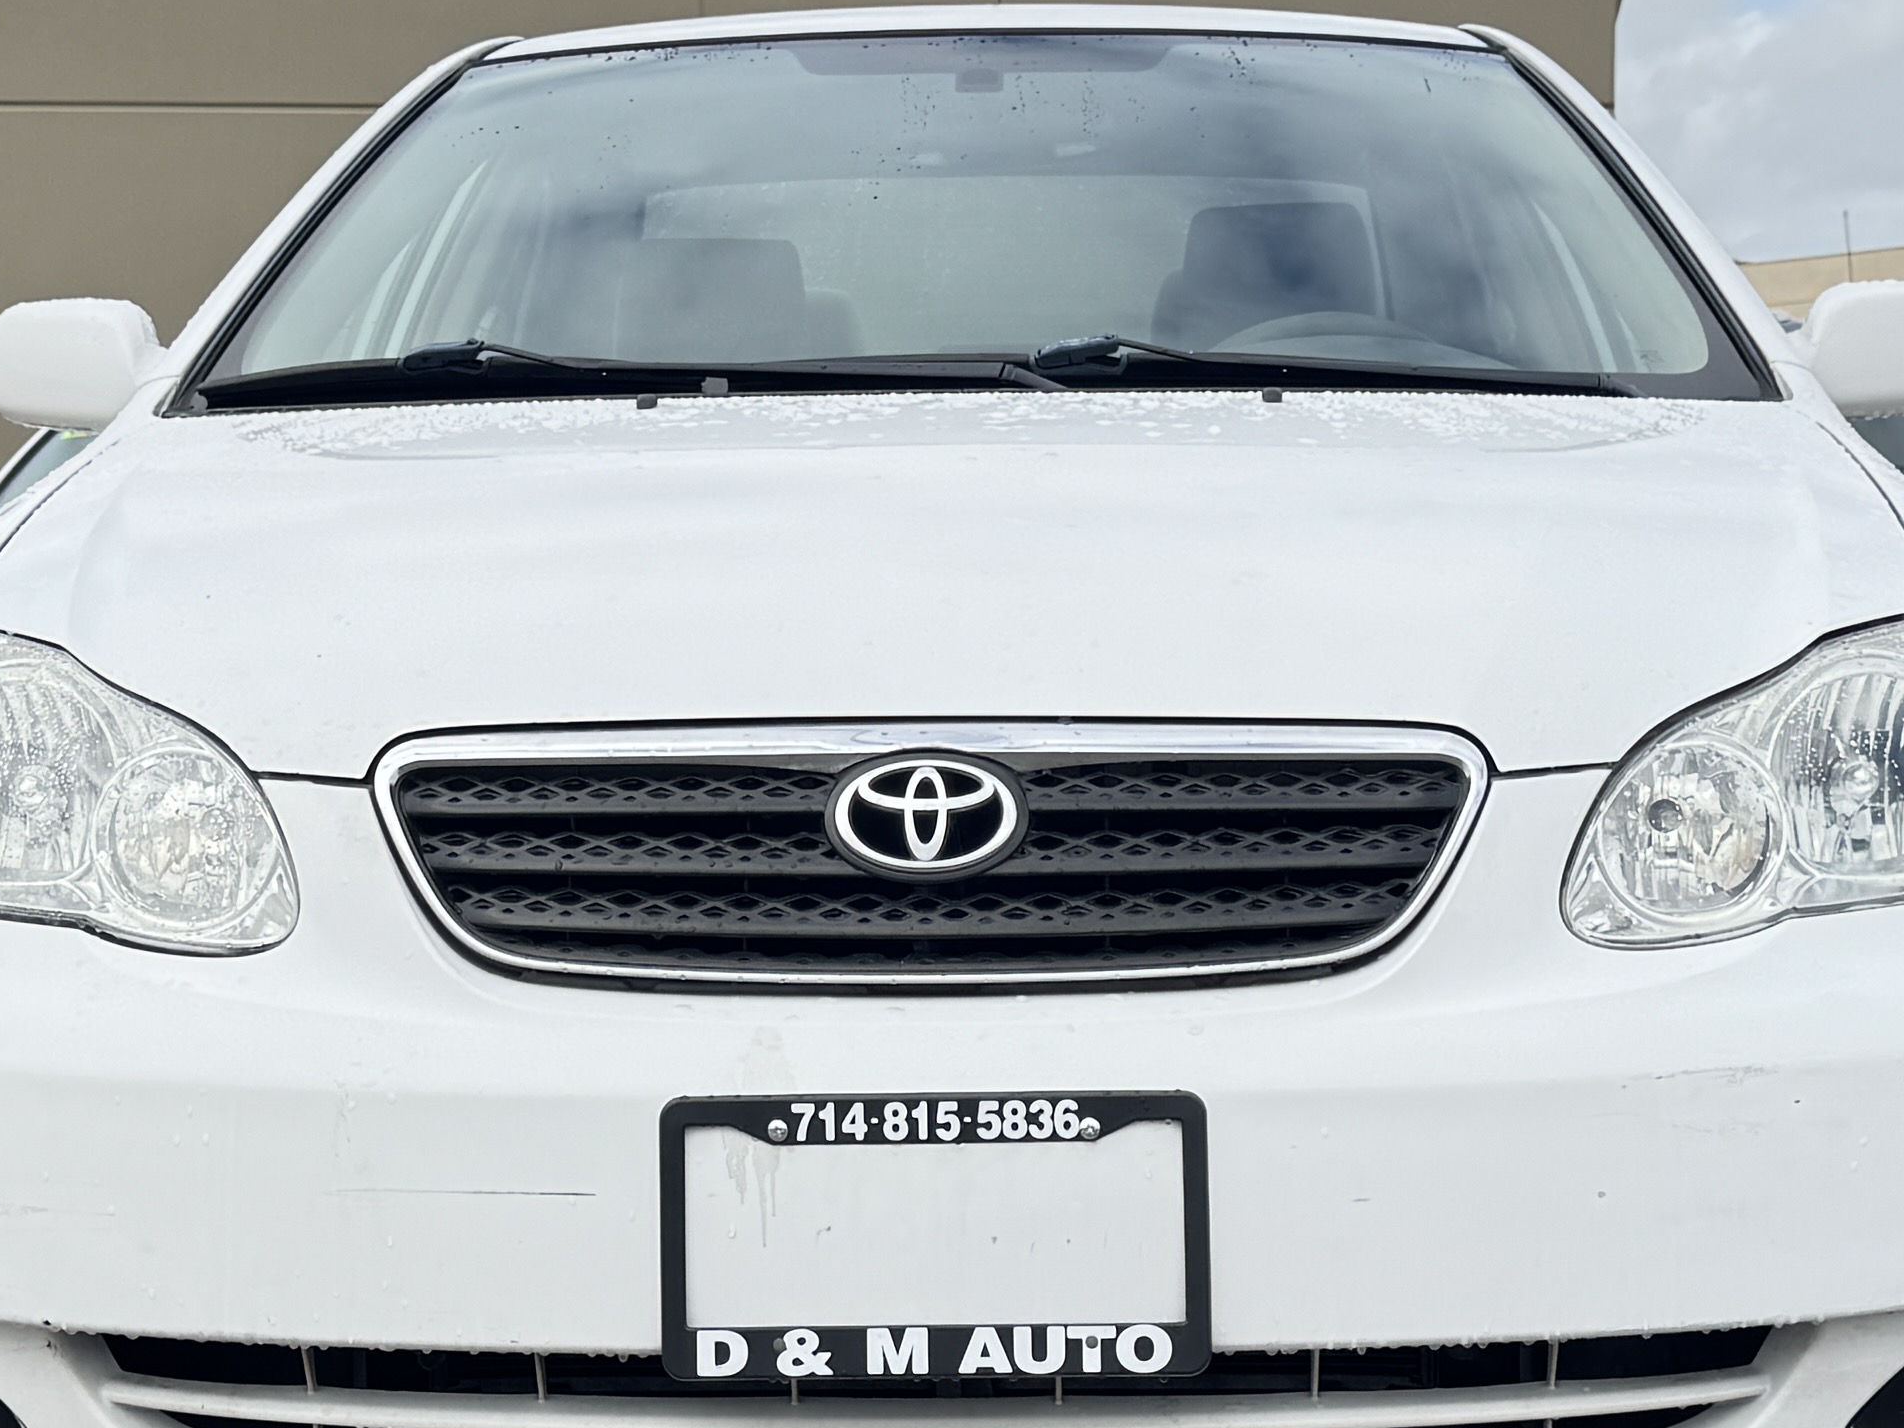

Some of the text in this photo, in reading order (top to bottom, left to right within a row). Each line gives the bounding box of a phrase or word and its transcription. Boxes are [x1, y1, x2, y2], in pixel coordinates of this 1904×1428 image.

[696, 1324, 1174, 1377] D & M AUTO
